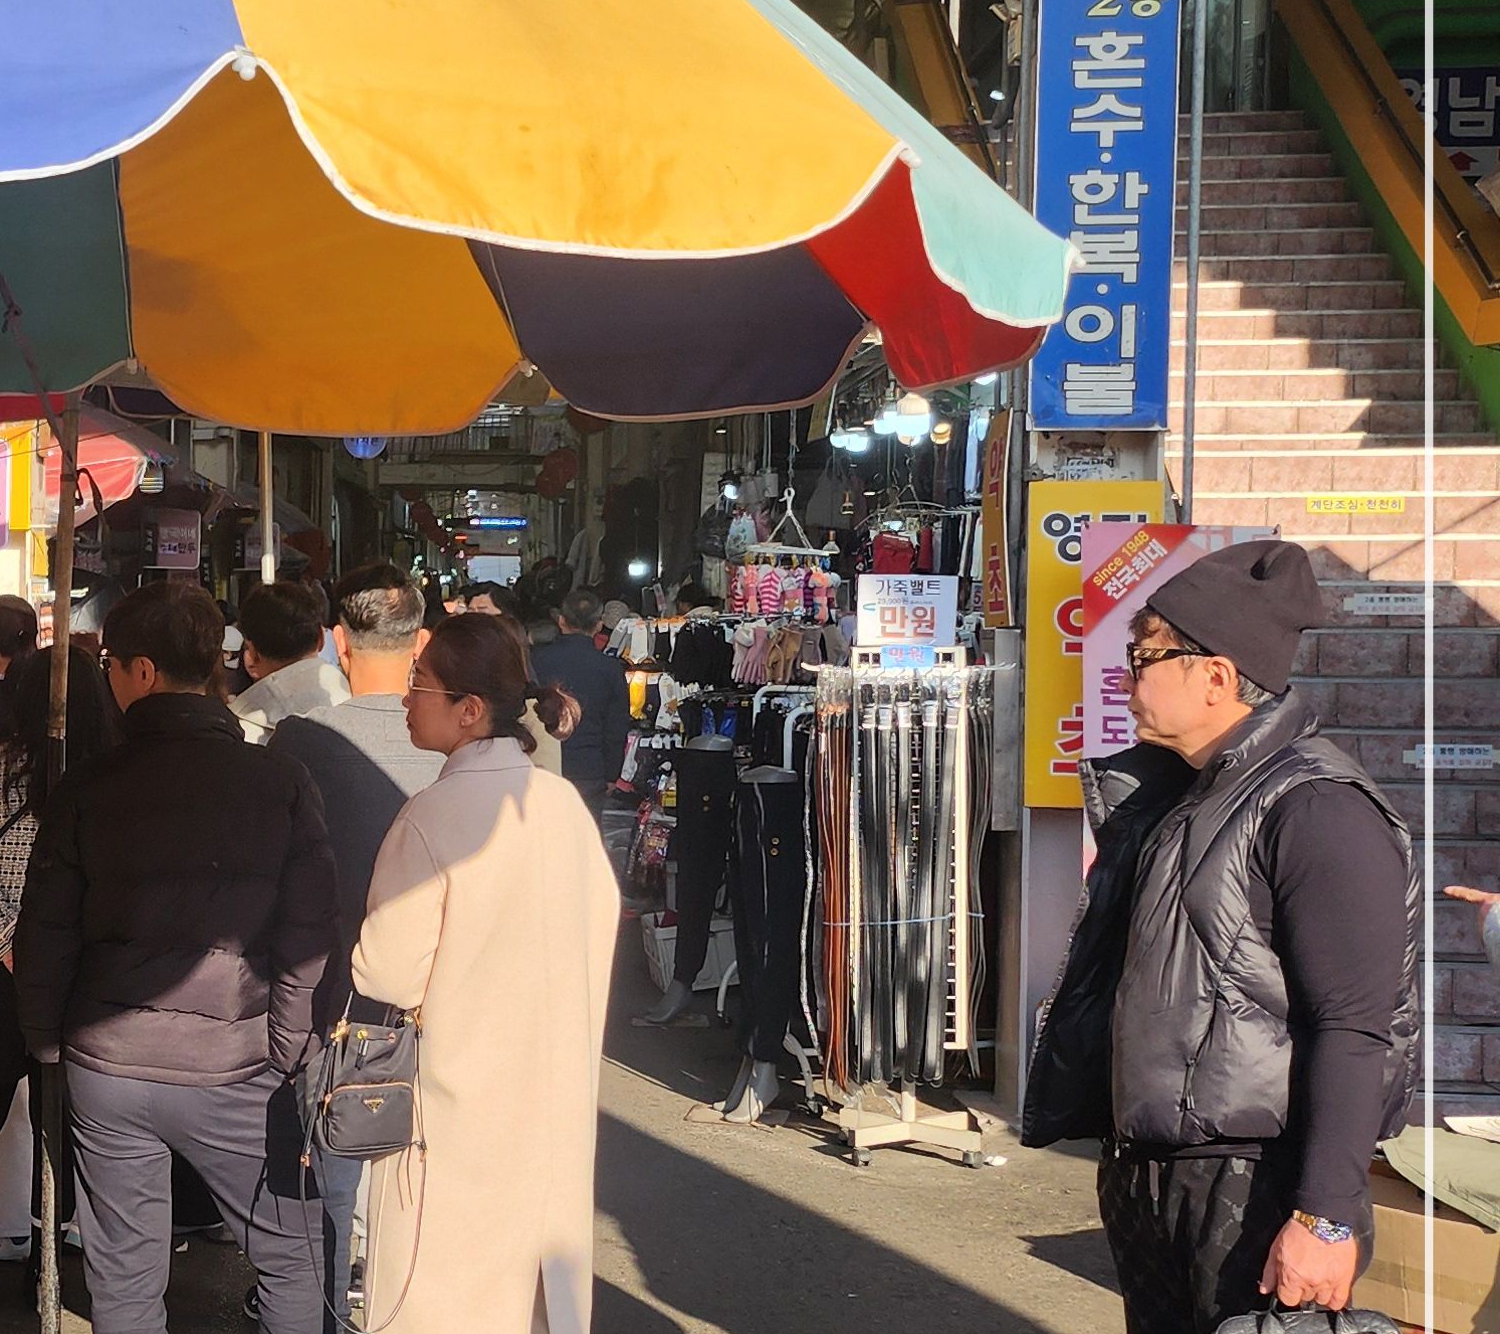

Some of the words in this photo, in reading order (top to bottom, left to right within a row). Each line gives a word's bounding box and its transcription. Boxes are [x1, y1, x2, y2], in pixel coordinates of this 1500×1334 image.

[1092, 554, 1123, 587] since
[1121, 529, 1150, 557] 1948
[1102, 537, 1168, 601] 전국최대
[880, 606, 936, 638] 만원
